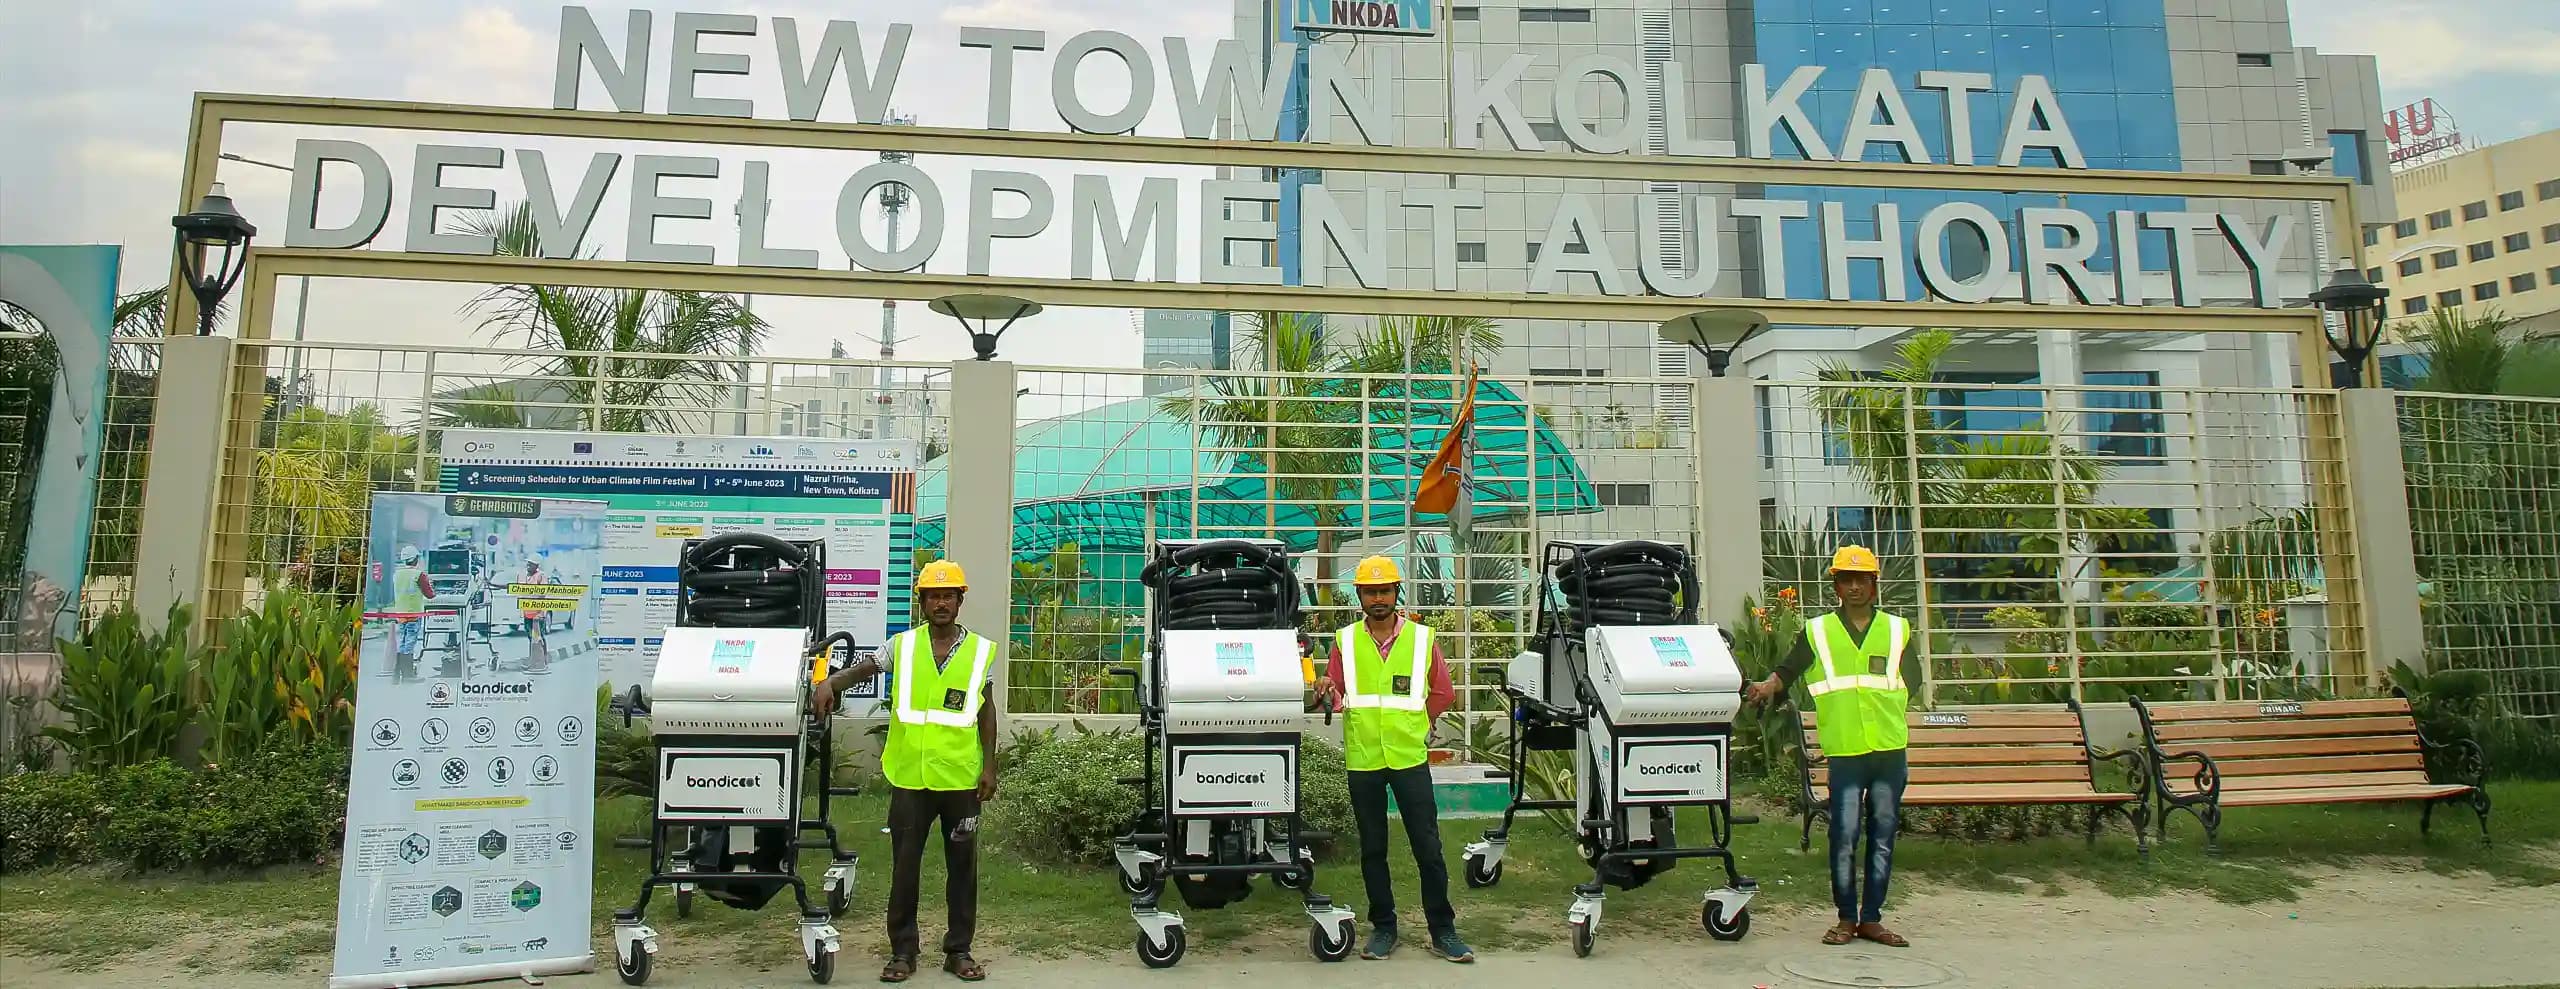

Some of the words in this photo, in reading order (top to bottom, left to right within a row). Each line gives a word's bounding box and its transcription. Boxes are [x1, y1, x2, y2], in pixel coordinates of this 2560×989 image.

[1332, 1, 1399, 28] NKDA
[553, 5, 912, 125] NEW
[960, 26, 1393, 146] TOWN
[1454, 49, 2087, 169] KOLKATA
[284, 138, 1485, 291] DEVELOPMENT
[1526, 192, 2296, 310] AUTHORITY
[483, 474, 526, 485] Screening
[527, 474, 567, 484] Schedule
[568, 475, 581, 484] for
[582, 475, 607, 484] Urban
[609, 475, 641, 485] Climate
[642, 476, 661, 485] Film
[662, 476, 696, 486] Festival
[743, 479, 763, 487] June
[764, 479, 785, 487] 2023
[803, 474, 830, 483] Nazrul
[831, 475, 859, 485] Tirtha,
[803, 486, 822, 494] New
[823, 486, 847, 496] Town,
[848, 486, 880, 495] Kolkata
[470, 499, 534, 514] GENROBOTICS
[669, 500, 688, 508] JUNE
[689, 500, 708, 508] 2023
[604, 570, 623, 578] JUNE
[624, 570, 644, 578] 2023
[833, 573, 853, 581] 2023
[511, 585, 546, 595] Changing
[546, 585, 581, 595] Manholes
[530, 601, 572, 609] Roboholes!
[461, 681, 533, 694] bandicoot
[2259, 705, 2302, 713] PRIMARC
[1923, 715, 1968, 723] PRIMARC
[1640, 762, 1701, 775] bandicoot
[687, 775, 761, 788] bandicoot
[1196, 771, 1266, 784] bandicoot
